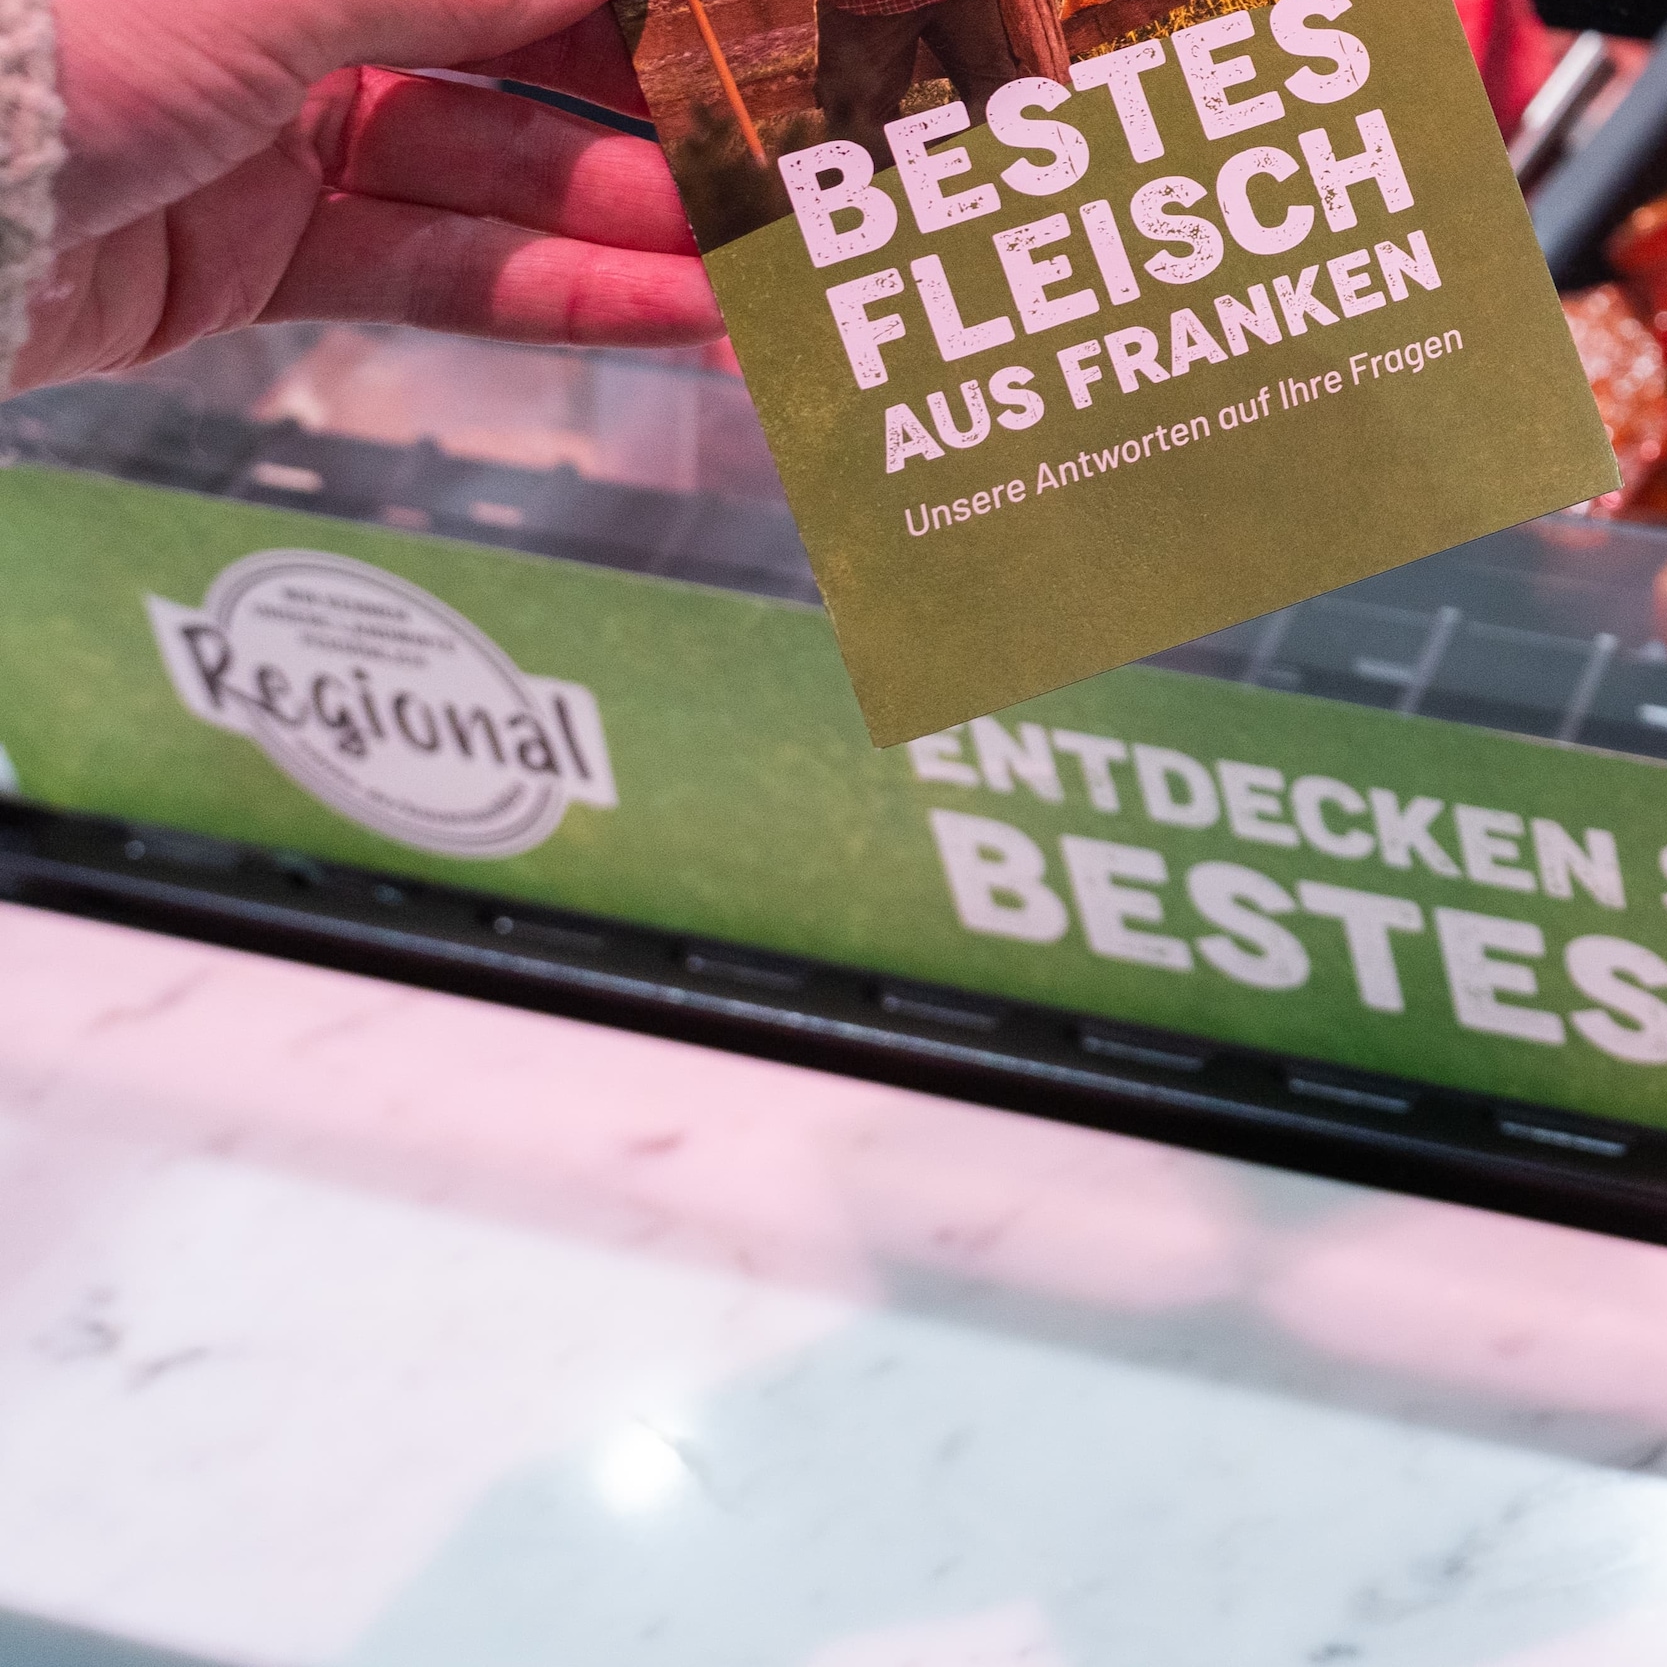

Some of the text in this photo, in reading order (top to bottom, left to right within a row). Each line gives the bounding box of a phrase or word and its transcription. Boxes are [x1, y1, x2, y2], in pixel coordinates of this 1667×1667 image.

[825, 108, 1416, 391] FLEISCH
[884, 229, 1442, 475] AUS FRANKEN
[903, 328, 1463, 539] Unsere Antworten auf Ihre Fragen
[181, 621, 592, 783] Regional
[905, 717, 1627, 910] ENTDECKEN
